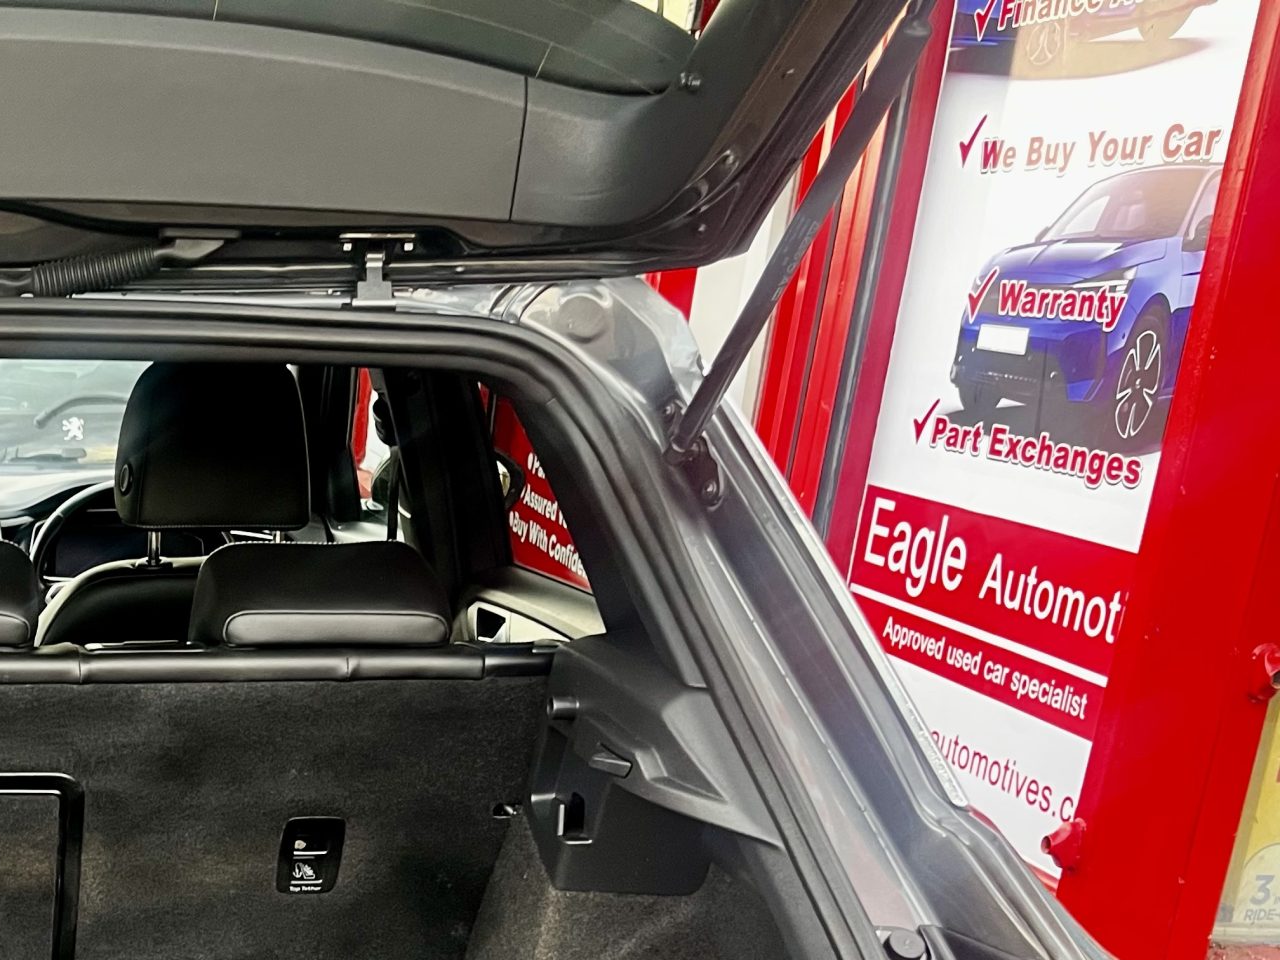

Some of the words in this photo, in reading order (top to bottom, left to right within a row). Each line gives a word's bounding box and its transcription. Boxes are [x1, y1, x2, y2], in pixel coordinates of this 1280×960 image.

[982, 138, 1016, 171] We
[1026, 136, 1075, 173] Buy
[1088, 130, 1153, 164] Your
[1163, 123, 1222, 160] Car
[998, 280, 1127, 331] Warranty
[930, 416, 983, 454] Part
[988, 425, 1141, 488] Exchanges
[523, 484, 558, 521] Assured
[512, 511, 529, 543] Buy
[529, 520, 548, 553] With
[864, 497, 967, 598] Eagle
[882, 616, 946, 660] Approved
[946, 645, 983, 676] used
[983, 660, 1010, 686] car
[1010, 673, 1089, 720] specialist
